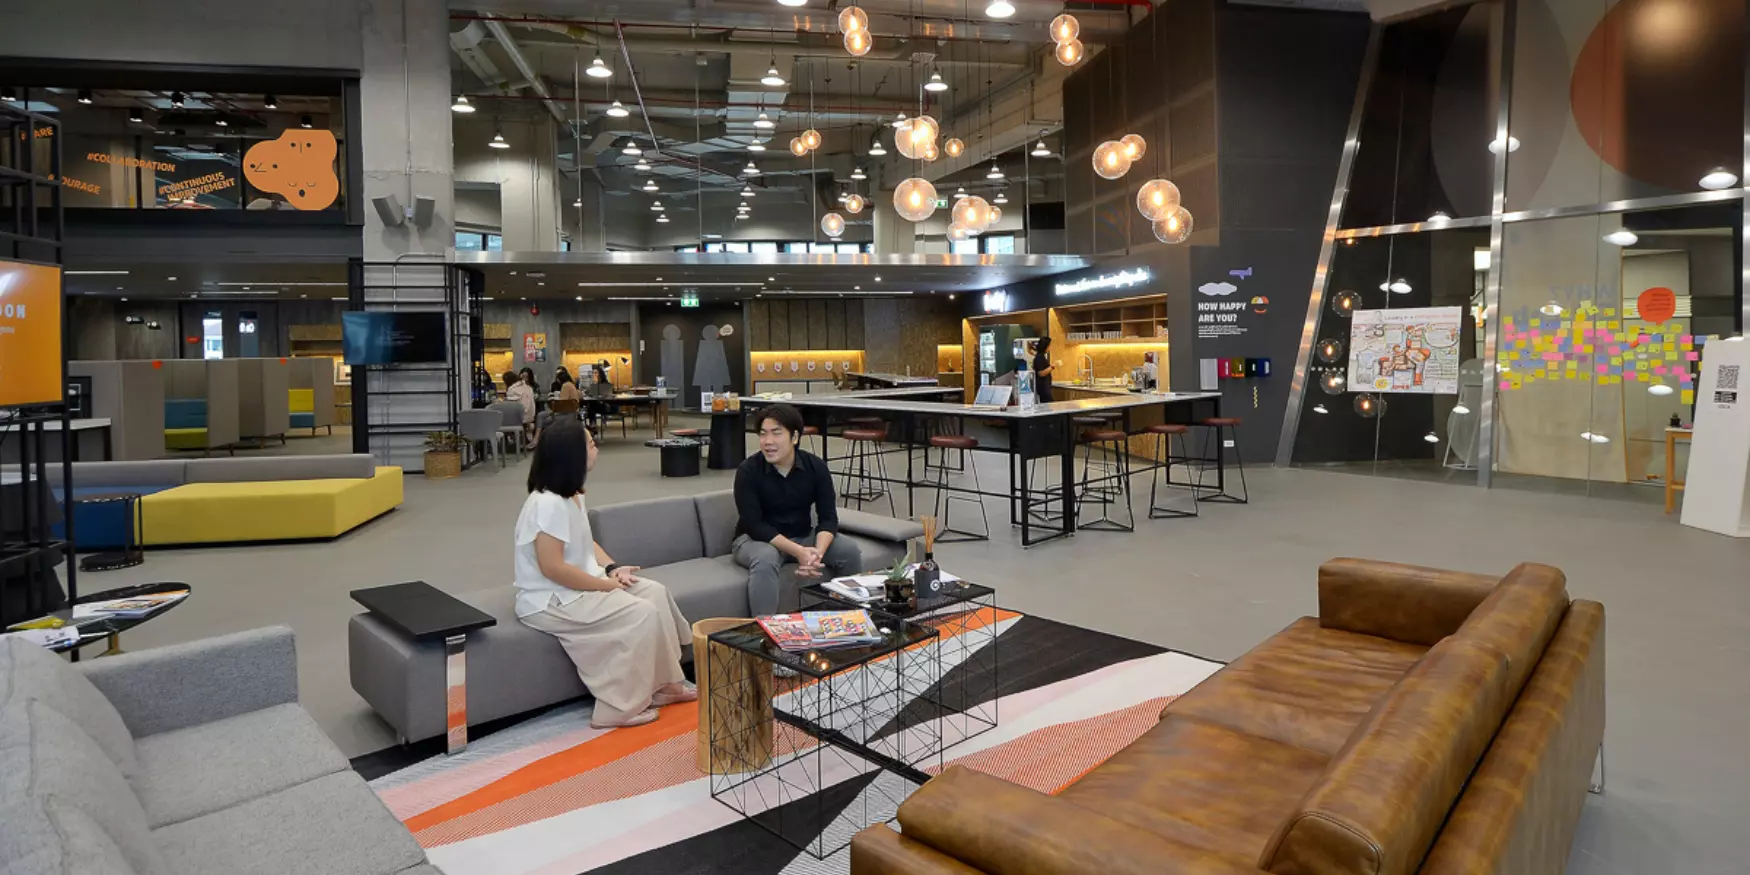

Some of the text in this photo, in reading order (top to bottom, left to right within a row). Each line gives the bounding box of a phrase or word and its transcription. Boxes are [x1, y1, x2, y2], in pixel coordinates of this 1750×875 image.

[87, 152, 176, 173] #COLLABORATION
[158, 171, 225, 195] #CONTINUOUS
[167, 177, 236, 201] IMPROVEMENT
[1198, 302, 1246, 311] HOW HAPPY
[1198, 313, 1238, 322] ARE YOU?
